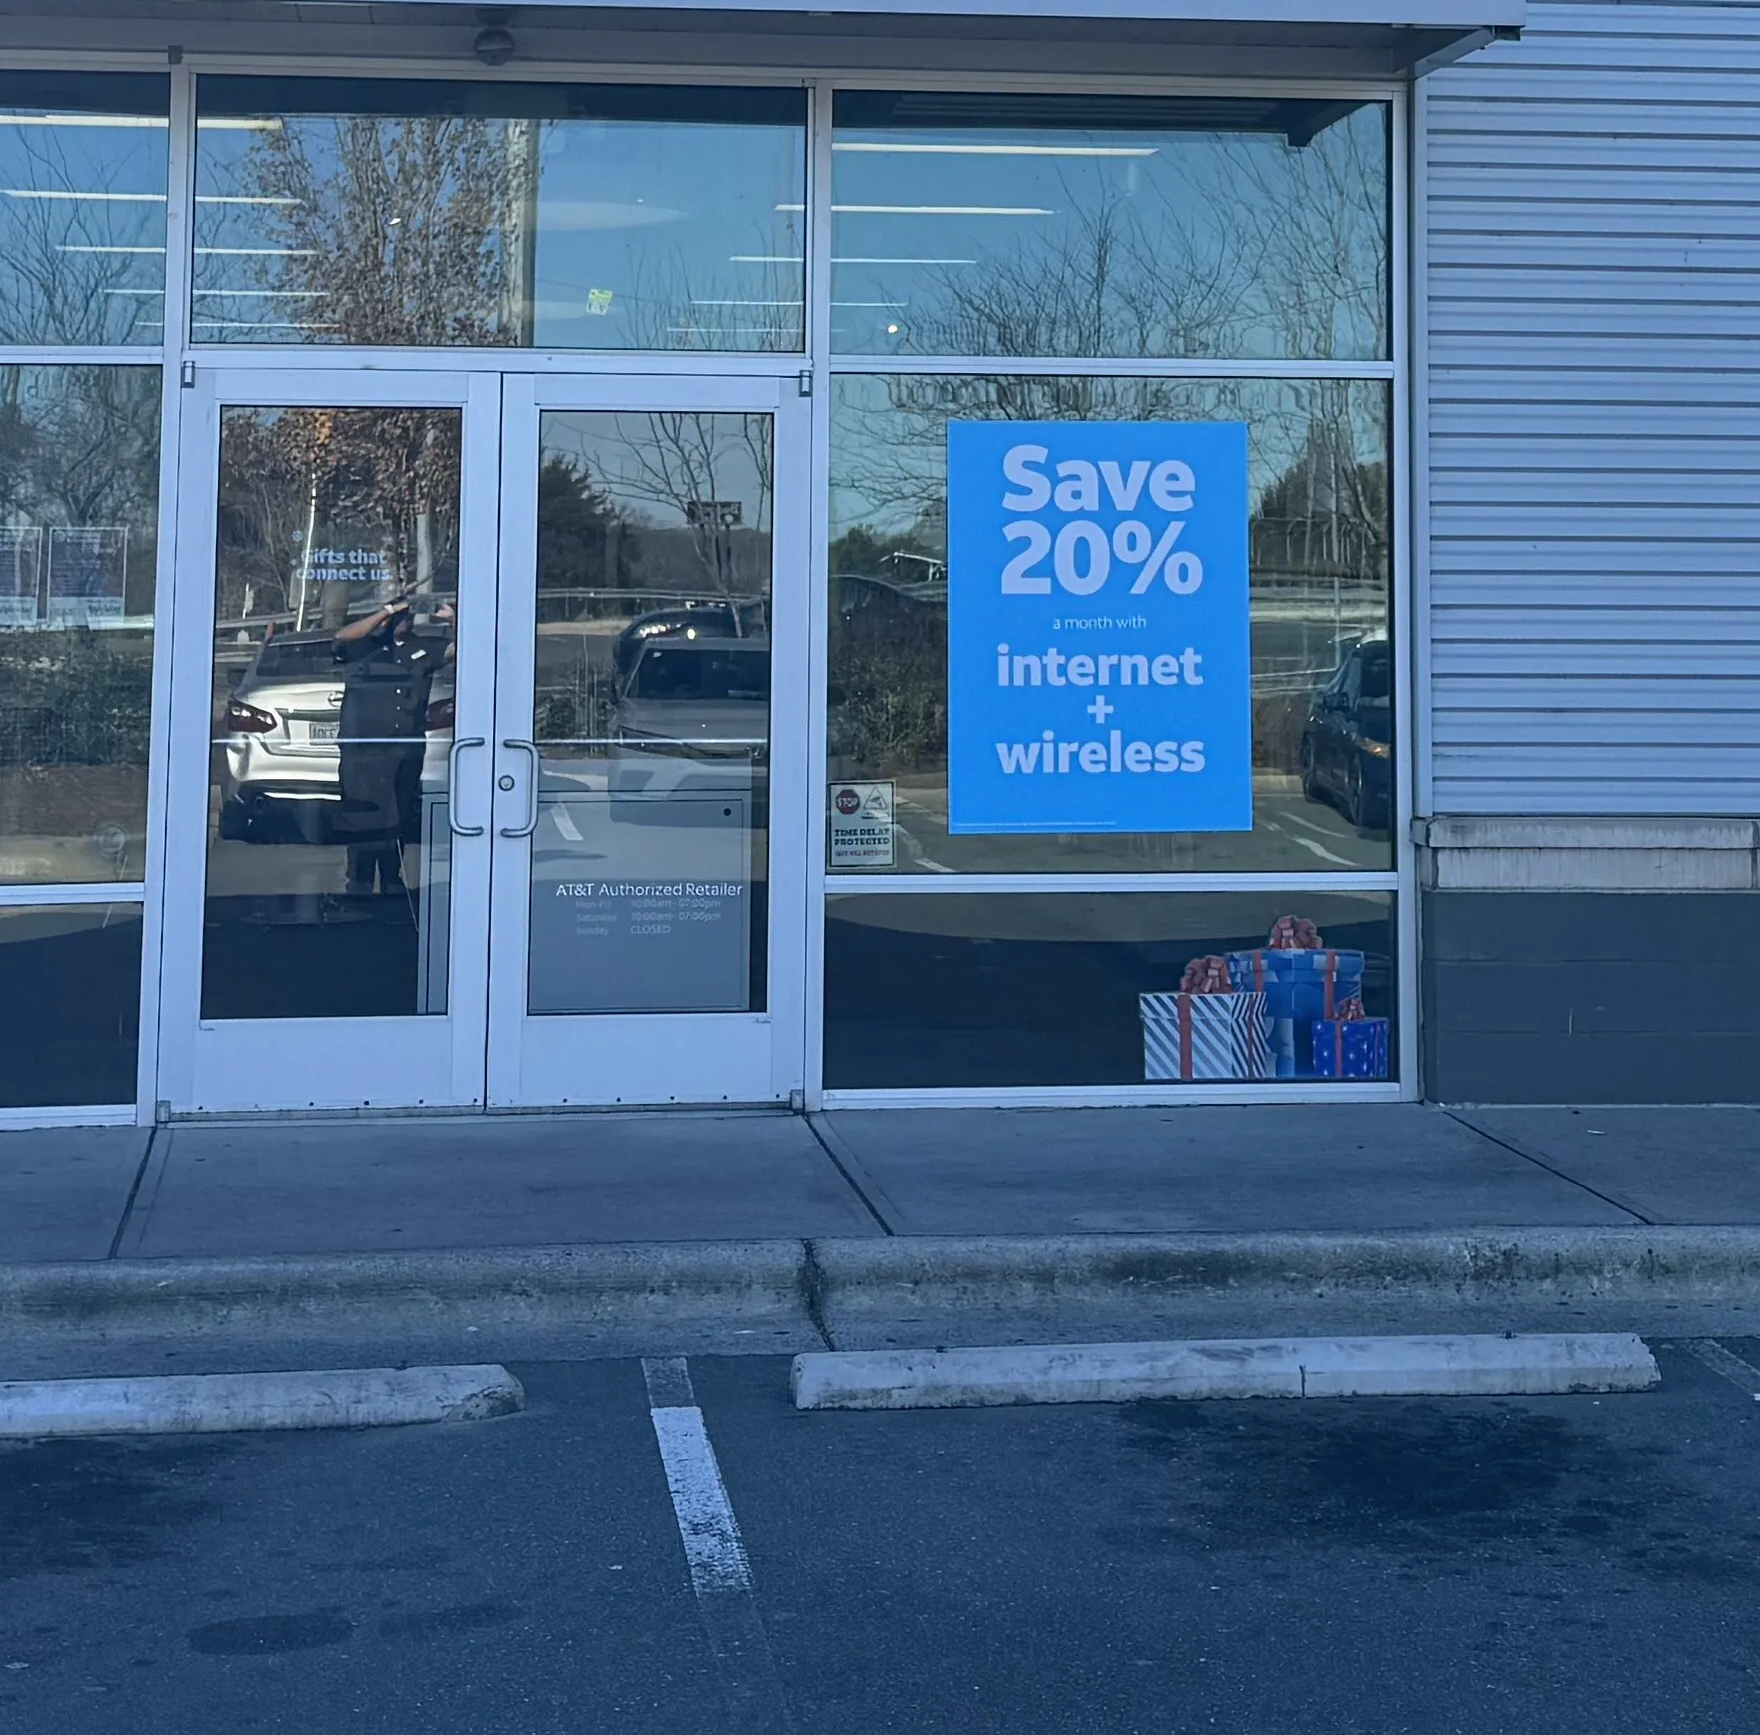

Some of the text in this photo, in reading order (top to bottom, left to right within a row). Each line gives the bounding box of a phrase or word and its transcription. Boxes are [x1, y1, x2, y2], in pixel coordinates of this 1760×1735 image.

[1001, 444, 1195, 512] Save
[349, 548, 387, 564] that
[1001, 519, 1203, 596] 20%
[296, 568, 390, 581] connect us
[1065, 617, 1112, 629] month
[1117, 616, 1147, 629] with
[997, 642, 1204, 686] internet
[995, 730, 1206, 774] wireless
[556, 883, 743, 897] AT&T Authorized Retailer
[630, 925, 672, 935] CLOSED
